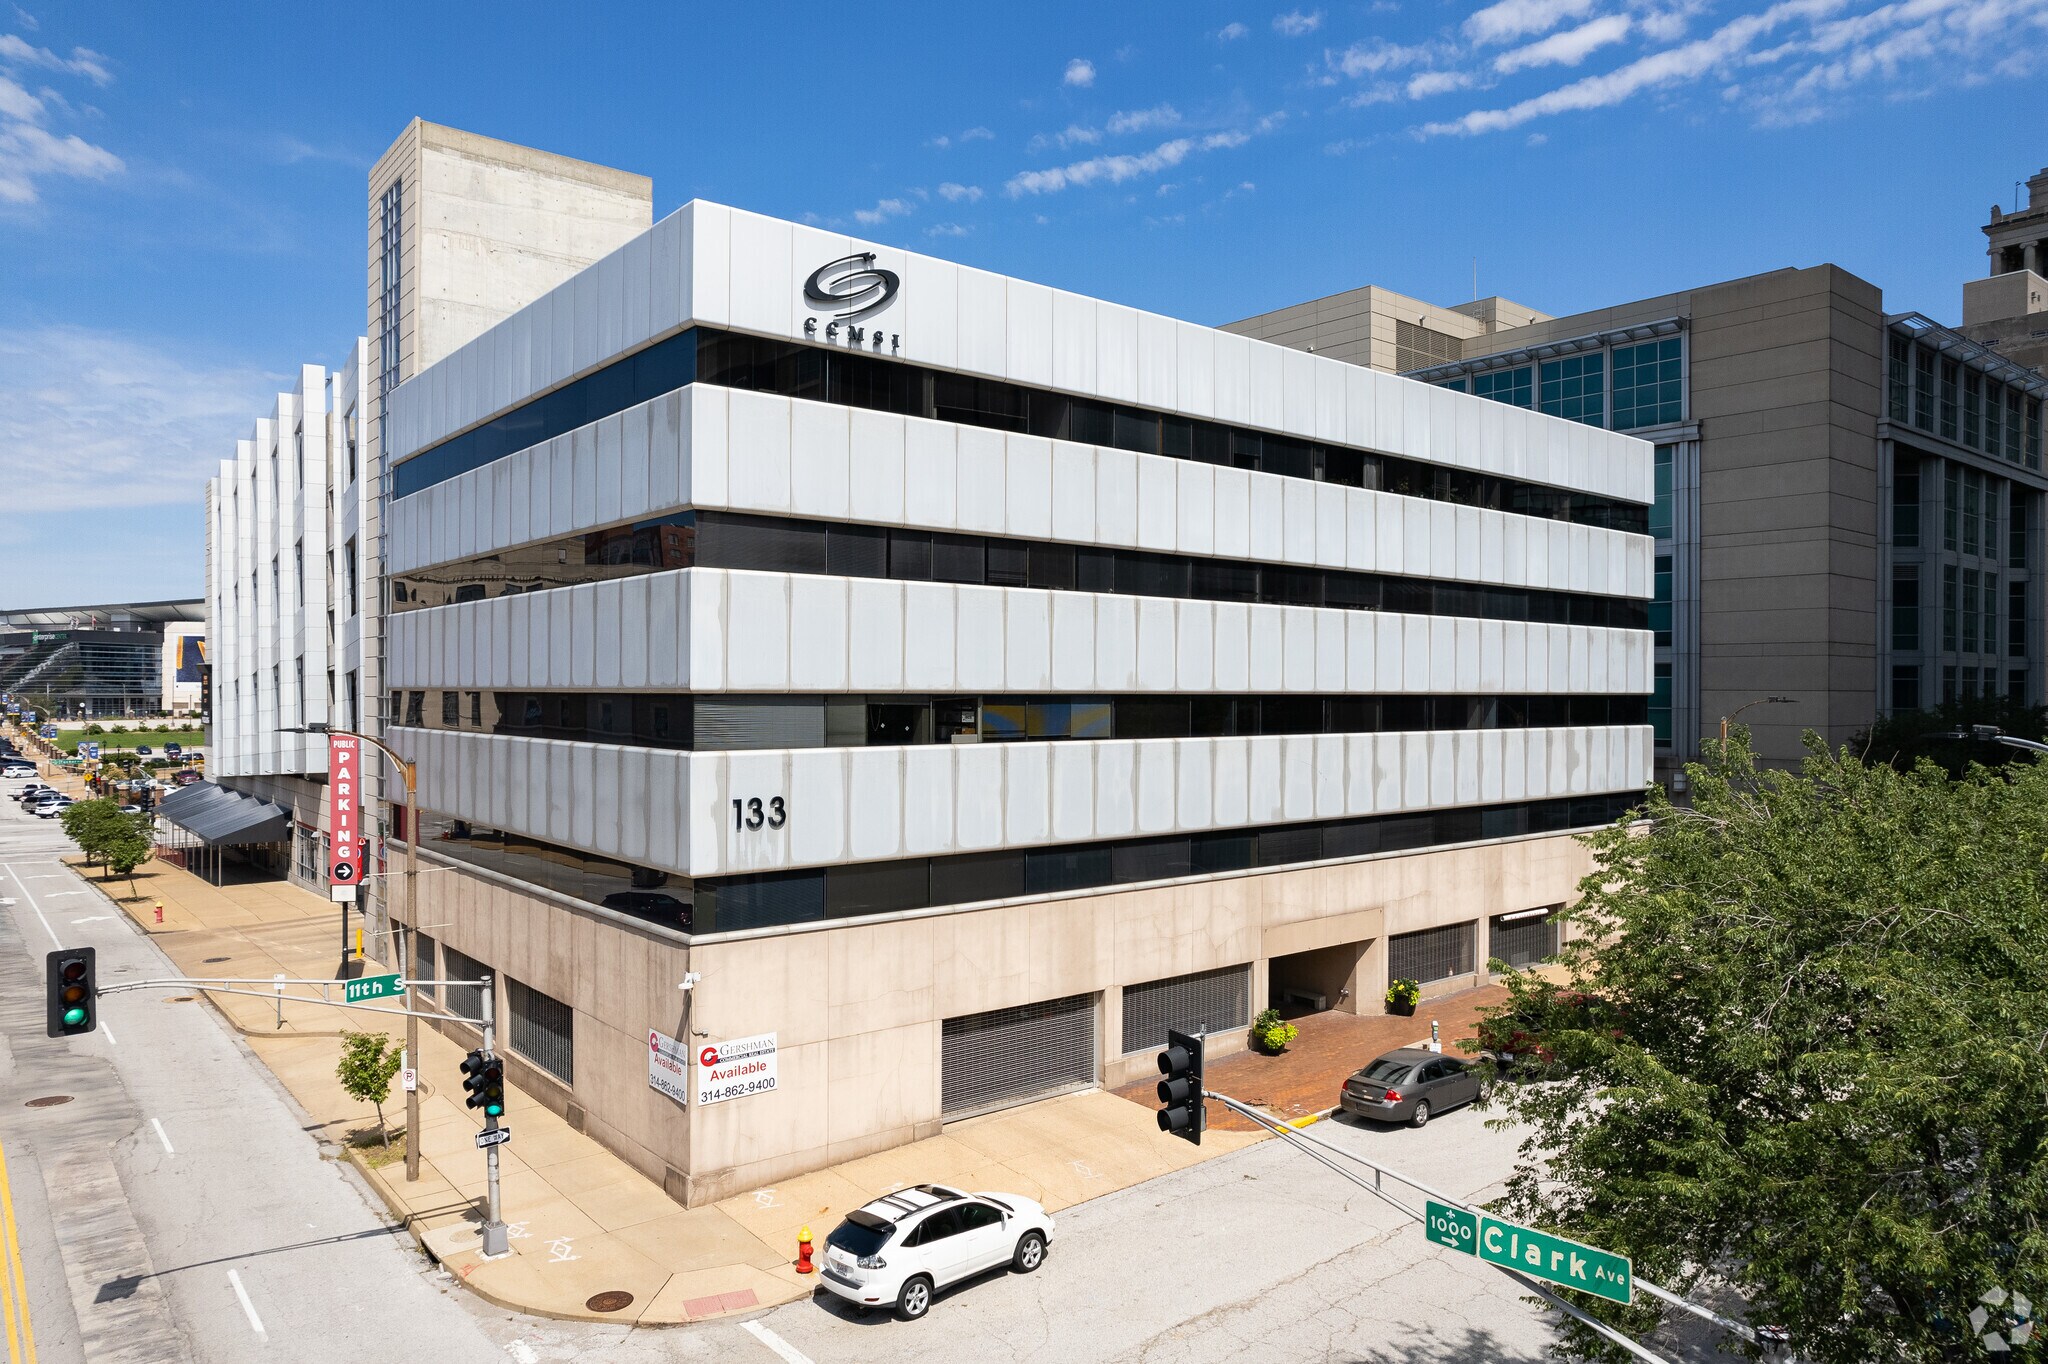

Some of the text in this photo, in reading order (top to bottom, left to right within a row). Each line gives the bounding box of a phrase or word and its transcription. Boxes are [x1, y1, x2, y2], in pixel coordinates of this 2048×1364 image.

[803, 317, 900, 348] CCMSI
[333, 739, 355, 749] PUBLIC
[337, 751, 351, 858] PARKING
[732, 796, 787, 831] 133
[349, 981, 383, 998] 11th
[720, 1038, 775, 1056] GERSHMAN
[654, 1052, 682, 1076] Available
[710, 1061, 767, 1082] Available
[701, 1077, 775, 1103] 314-862-9400
[1430, 1215, 1471, 1240] 1000
[1484, 1226, 1625, 1286] Clark Ave
